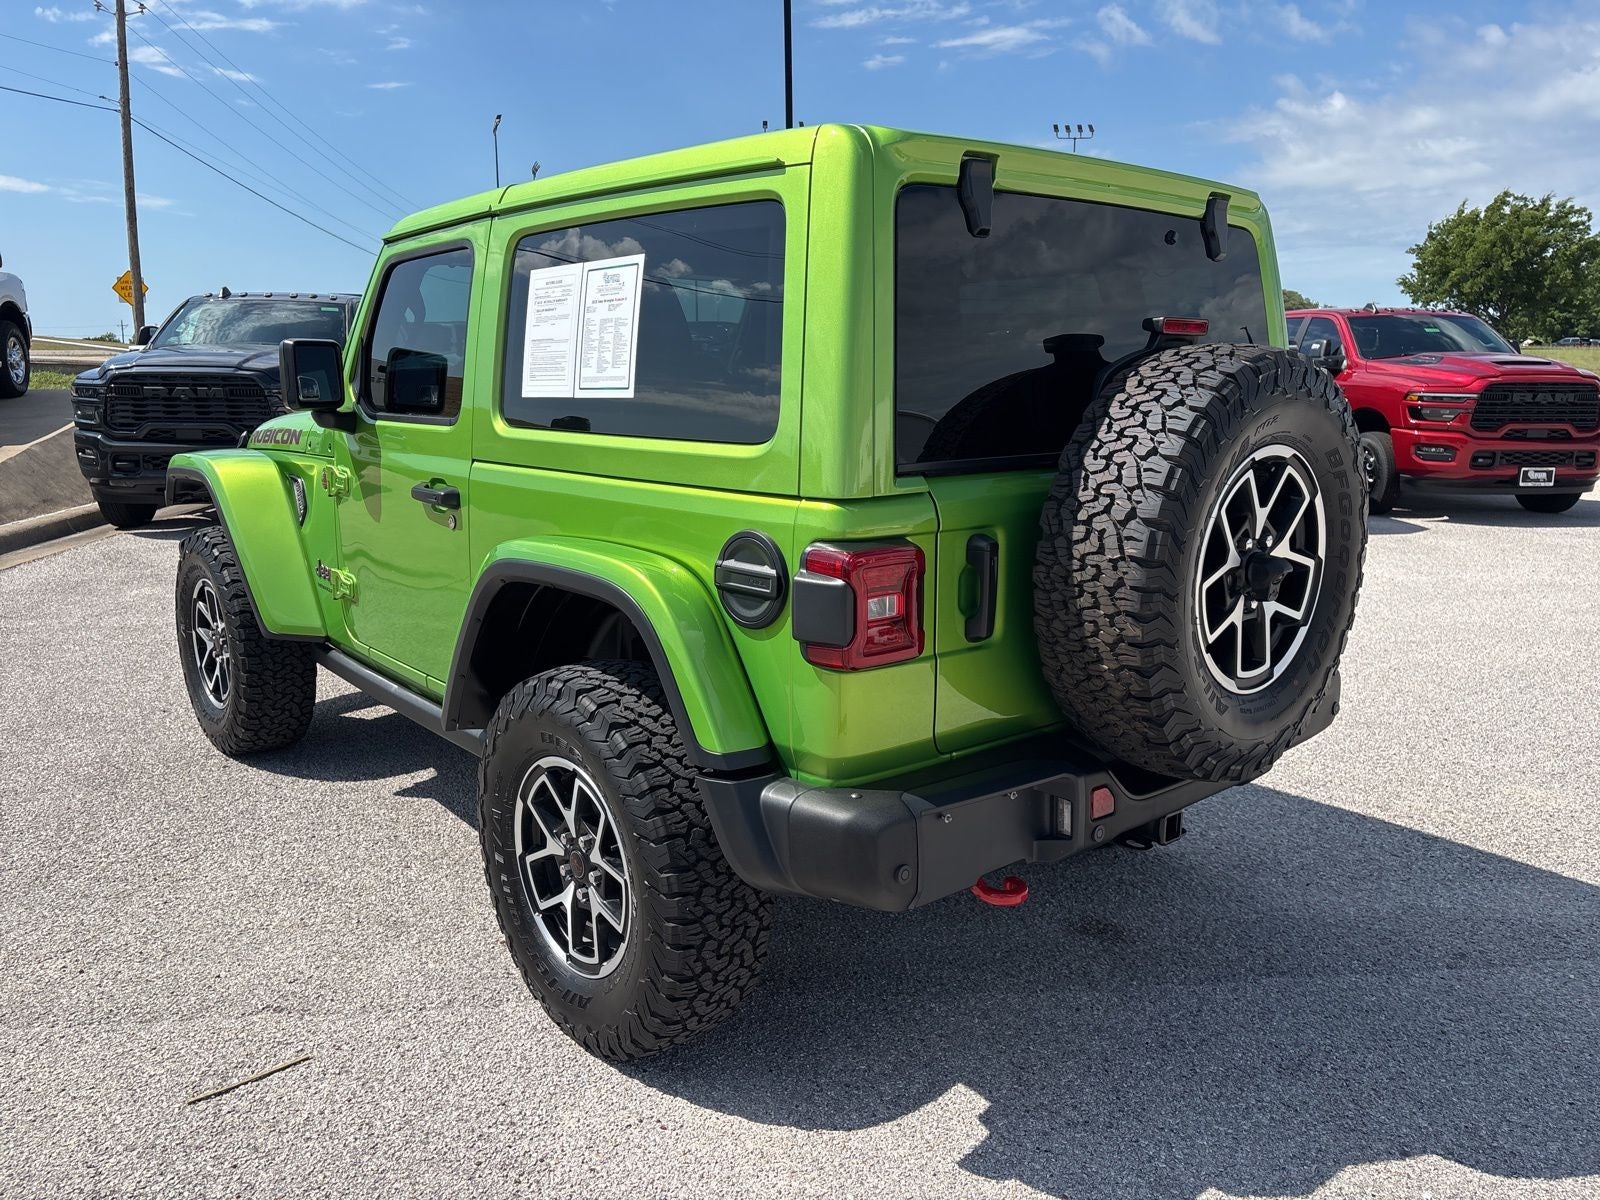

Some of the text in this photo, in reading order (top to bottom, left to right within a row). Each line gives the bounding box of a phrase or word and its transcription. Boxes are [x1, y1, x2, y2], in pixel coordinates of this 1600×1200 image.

[143, 386, 224, 399] RAM
[1512, 392, 1575, 403] RAM
[250, 428, 303, 445] RUBICON
